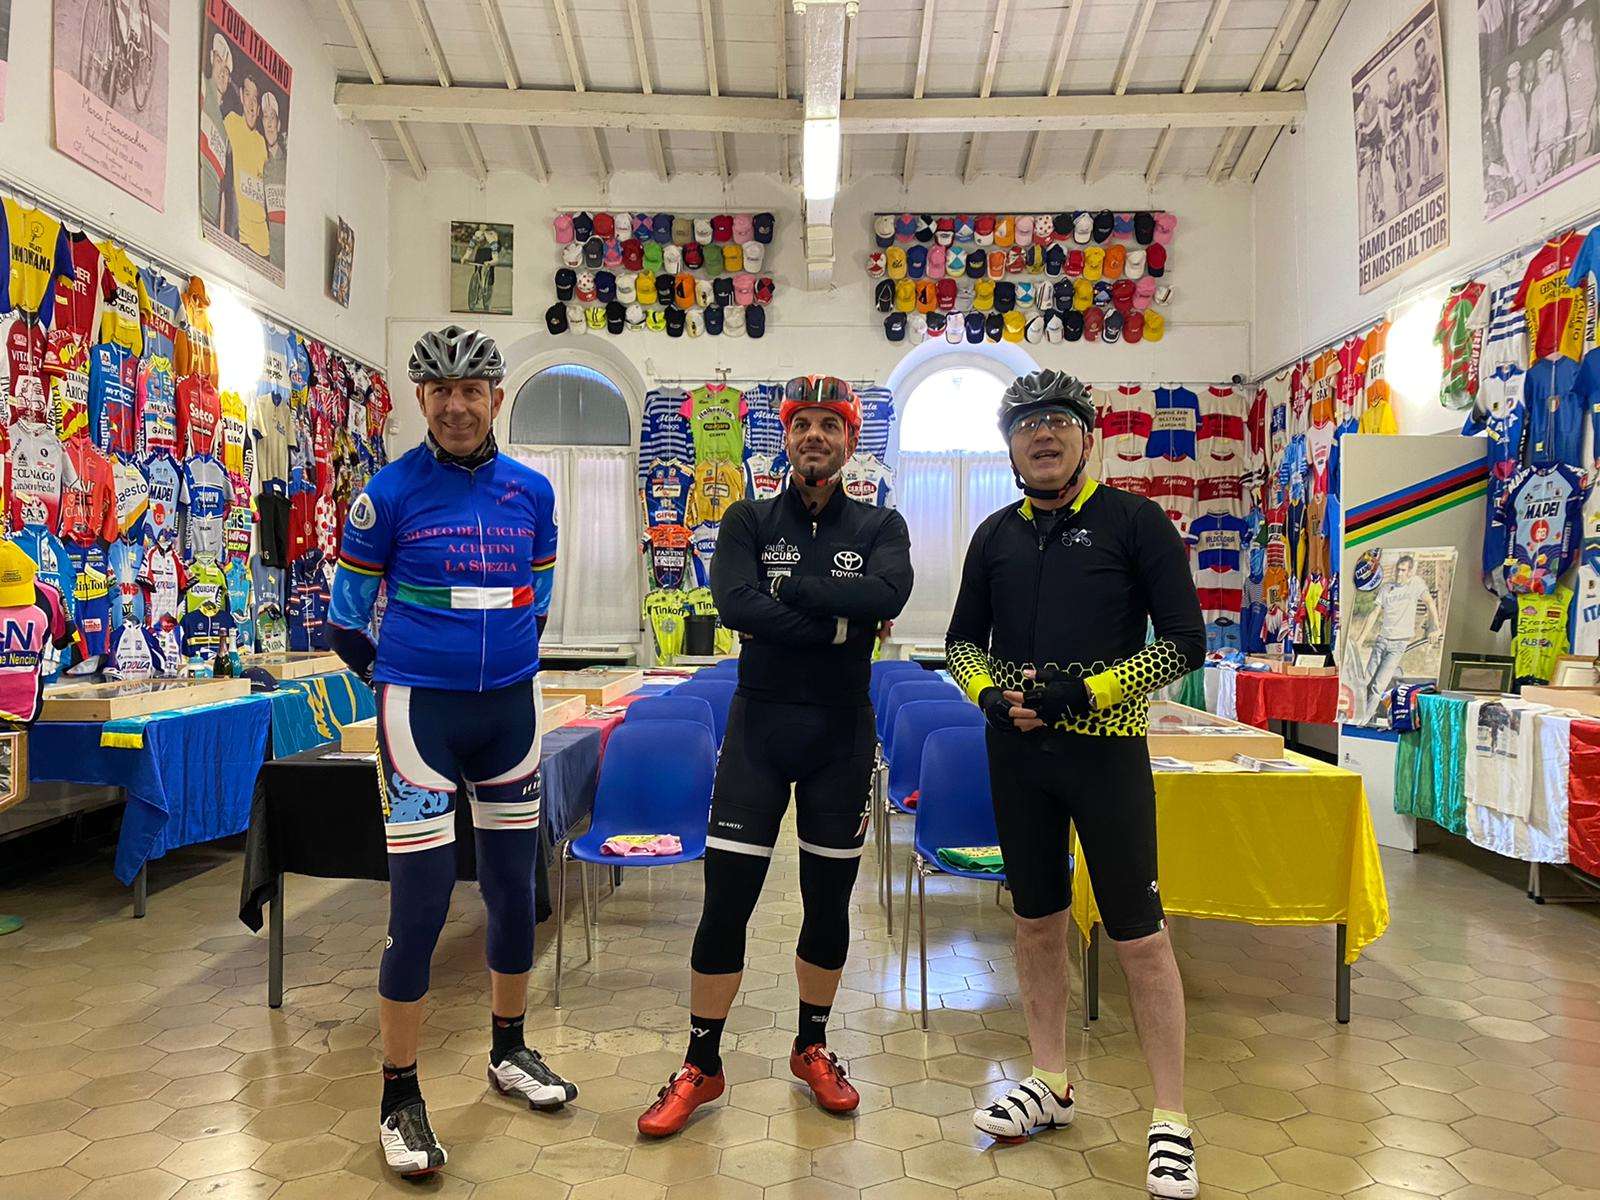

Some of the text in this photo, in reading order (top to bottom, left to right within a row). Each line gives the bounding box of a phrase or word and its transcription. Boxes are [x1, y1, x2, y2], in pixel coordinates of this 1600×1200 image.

[222, 0, 246, 47] TOUR
[249, 30, 290, 90] ITALIANO
[1359, 191, 1447, 265] SIAMO ORGOGLIOSI
[1359, 218, 1447, 287] DEI NOSTRI AL TOUR
[189, 402, 214, 424] Saeco
[149, 485, 174, 503] MAPEI
[1523, 501, 1560, 520] MAPEI
[403, 526, 454, 542] MUSEO
[761, 551, 801, 561] INCUBO
[786, 544, 799, 552] DA
[444, 559, 518, 573] LA SPEZIA
[830, 569, 864, 578] TOYOTA
[9, 654, 38, 667] Nencini
